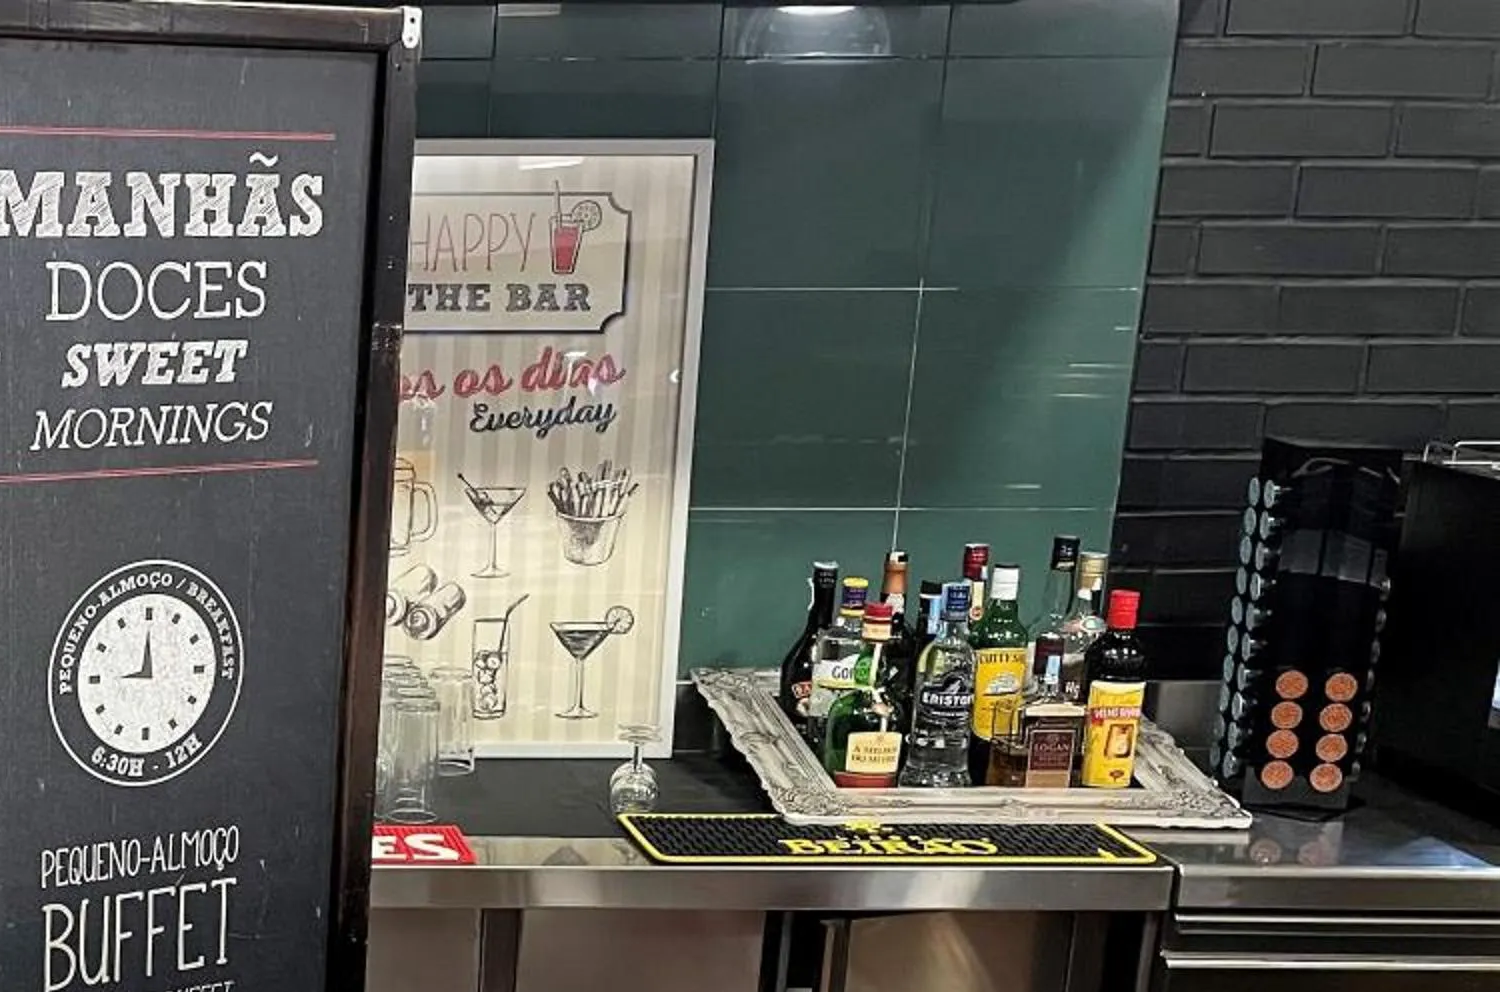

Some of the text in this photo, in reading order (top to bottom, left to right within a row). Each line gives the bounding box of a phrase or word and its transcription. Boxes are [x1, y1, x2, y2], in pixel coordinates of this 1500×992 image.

[408, 212, 537, 273] HAPPY
[45, 261, 268, 321] DOCES
[407, 283, 592, 312] THE BAR
[60, 339, 248, 388] SWEET
[453, 364, 513, 398] os
[28, 401, 273, 451] MORNINGS
[470, 396, 617, 439] Everyday
[40, 825, 239, 889] PEQUENO-ALMOÇO
